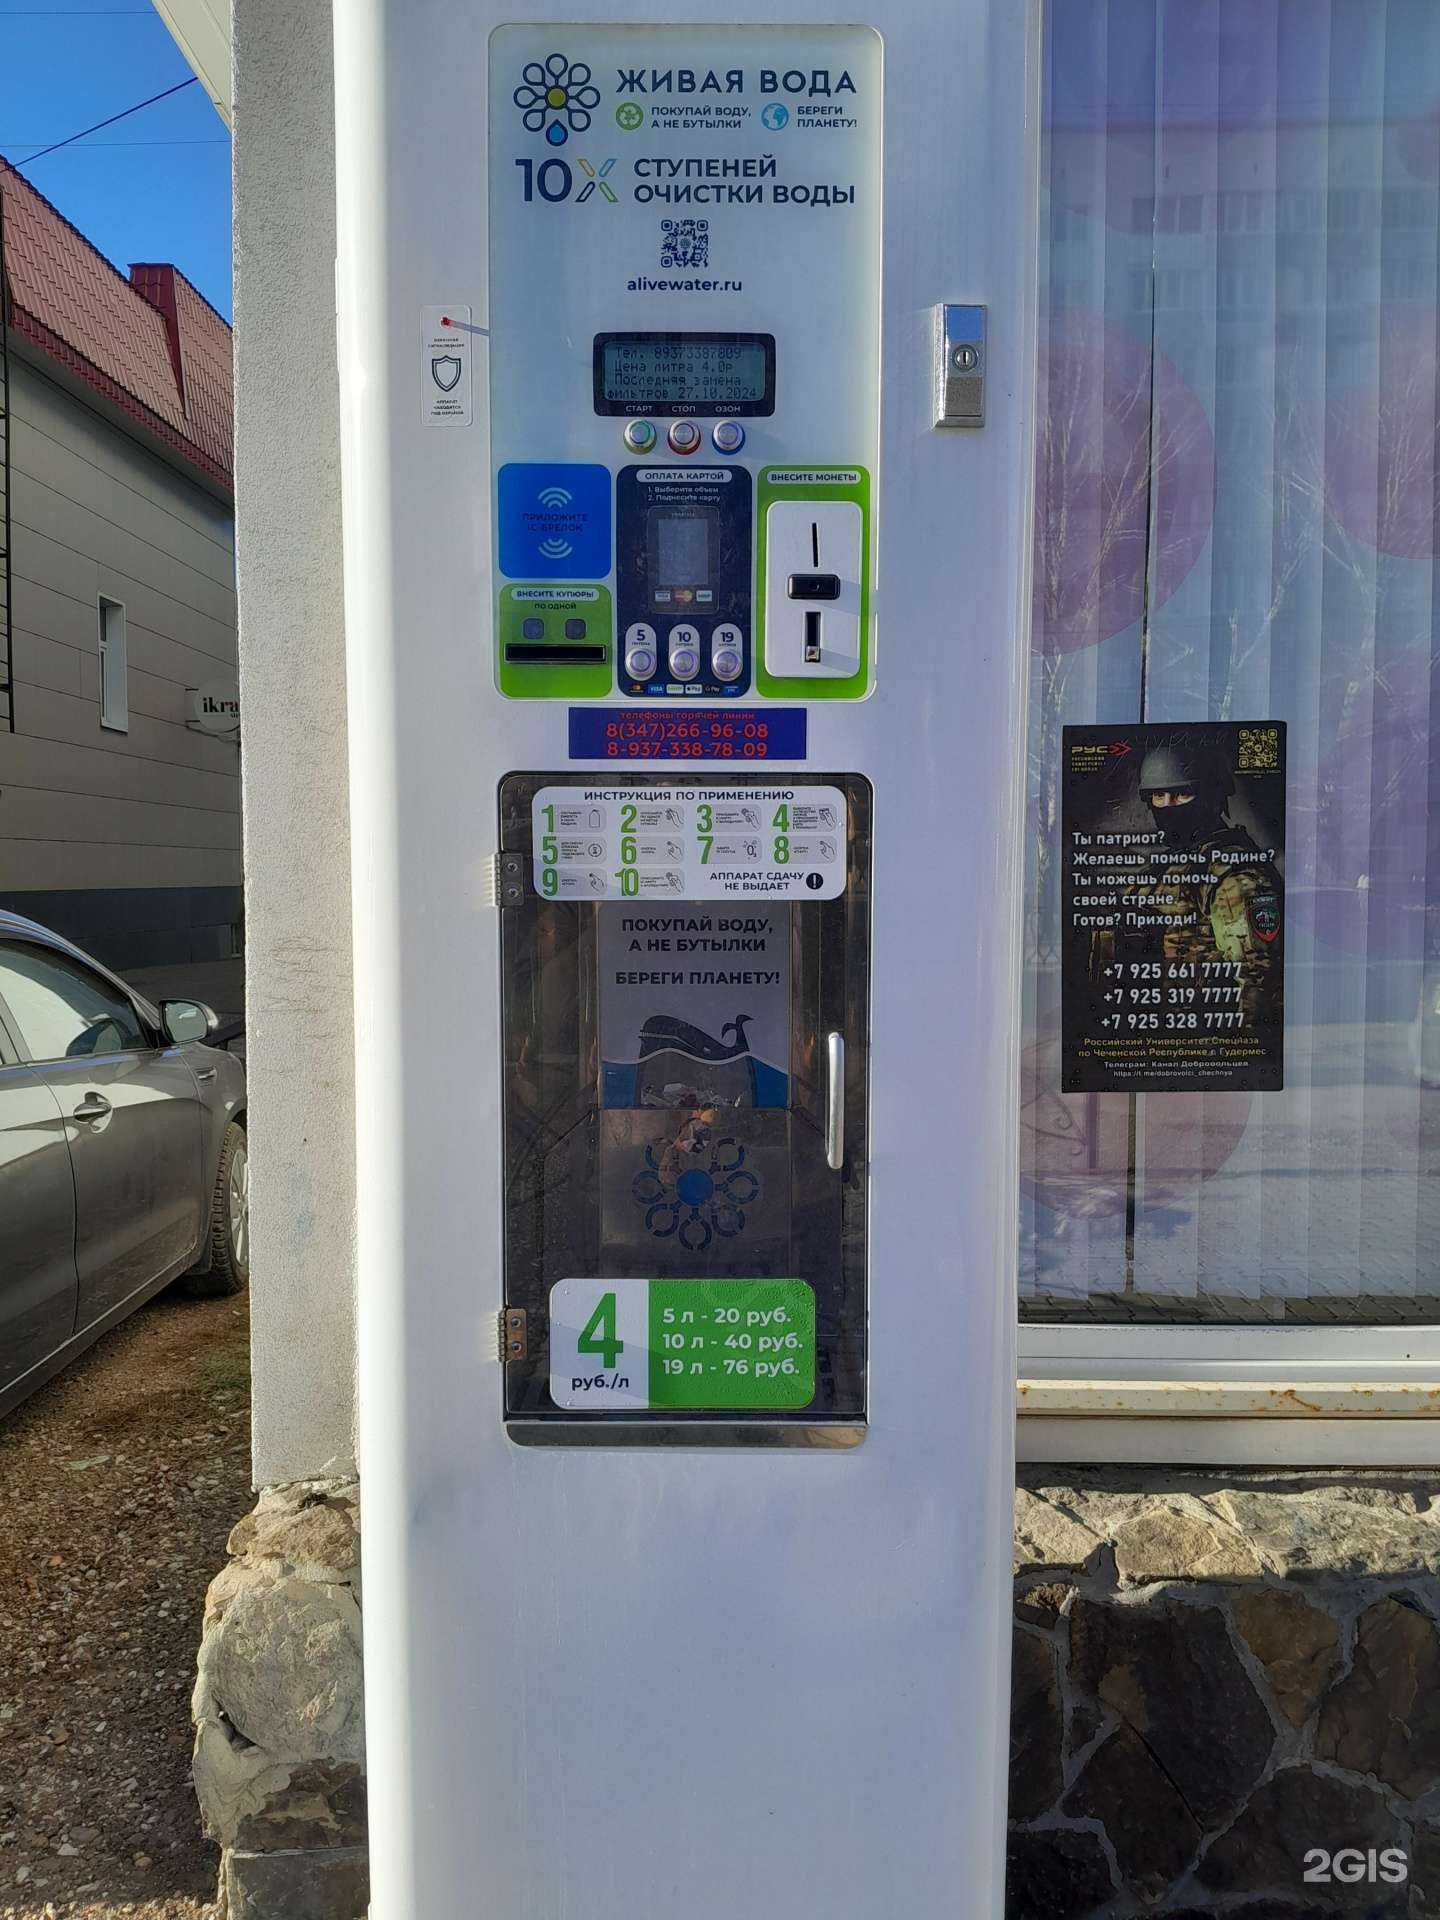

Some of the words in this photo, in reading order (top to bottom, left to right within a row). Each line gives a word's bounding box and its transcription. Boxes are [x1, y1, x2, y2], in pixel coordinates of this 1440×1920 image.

[615, 69, 744, 94] ЖИВАЯ
[759, 69, 857, 98] ВОДА
[651, 104, 712, 117] ПОКУПАЙ
[715, 105, 752, 119] ВОДУ,
[796, 105, 843, 116] БЕРЕГИ
[651, 119, 660, 129] А
[662, 119, 681, 129] НЕ
[683, 119, 742, 129] БУТЫЛКИ
[796, 119, 858, 129] ПЛАНЕТУ!
[633, 154, 777, 178] СТУПЕНЕЙ
[633, 184, 763, 204] ОЧИСТКИ
[772, 184, 855, 207] ВОДЫ
[626, 277, 743, 292] alivewater.ru
[614, 360, 647, 373] Цена
[654, 361, 694, 373] литра
[614, 373, 686, 386] Последняя
[625, 405, 653, 413] СТАРТ
[671, 405, 696, 413] СТОП
[715, 405, 741, 413] ОЗОН
[644, 472, 684, 481] ОПЛАТА
[686, 471, 725, 481] КАРТОЙ
[770, 472, 812, 482] ВНЕСИТЕ
[814, 472, 858, 482] МОНЕТЫ
[522, 513, 589, 522] ПРИЛОЖИТЕ
[516, 590, 555, 598] ВНЕСИТЕ
[556, 590, 594, 599] КУПЮРЫ
[547, 602, 577, 611] ОДНОЙ
[636, 629, 646, 642] 5
[676, 631, 692, 643] 10
[720, 631, 734, 643] 19
[202, 697, 239, 713] ikra
[620, 711, 673, 721] телефоны
[606, 723, 769, 741] 8(347)266-96-08
[607, 742, 768, 757] 8-937-338-78-09
[584, 791, 673, 802] ИНСТРУКЦИЯ
[676, 791, 696, 801] ПО
[699, 790, 795, 801] ПРИМЕНЕНИЮ
[541, 804, 554, 833] 1
[620, 804, 638, 833] 2
[696, 804, 713, 833] 3
[772, 803, 790, 833] 4
[1071, 832, 1092, 845] Ты
[1096, 830, 1165, 848] патриот?
[542, 835, 558, 865] 5
[621, 836, 637, 865] 6
[696, 835, 714, 864] 7
[773, 835, 790, 865] 8
[1072, 852, 1145, 866] Желаешь
[1150, 852, 1206, 865] помочь
[1211, 849, 1275, 864] Родине?
[542, 867, 558, 897] 9
[614, 867, 639, 897] 10
[709, 872, 764, 881] АППАРАТ
[766, 871, 805, 882] СДАЧУ
[1071, 872, 1092, 886] Ты
[1096, 874, 1158, 885] можешь
[1162, 874, 1219, 885] помочь
[724, 882, 740, 890] НЕ
[742, 882, 791, 891] ВЫДАЕТ
[1073, 892, 1117, 906] своей
[1121, 894, 1178, 907] стране.
[621, 914, 715, 933] ПОКУПАЙ
[718, 918, 773, 934] ВОДУ,
[1073, 912, 1121, 927] Готов?
[1126, 911, 1198, 927] Приходи!
[629, 938, 642, 952] А
[647, 939, 672, 952] НЕ
[675, 938, 766, 952] БУТЫЛКИ
[615, 972, 685, 985] БЕРЕГИ
[689, 971, 781, 985] ПЛАНЕТУ!
[1103, 963, 1124, 979] +7
[1130, 963, 1162, 979] 925
[1167, 962, 1195, 978] 661
[1201, 962, 1242, 978] 7777
[1103, 988, 1124, 1005] +7
[1129, 988, 1161, 1004] 925
[1167, 987, 1196, 1004] 319
[1201, 987, 1242, 1003] 7777
[1101, 1013, 1121, 1030] +7
[1127, 1013, 1159, 1029] 925
[1165, 1012, 1198, 1029] 328
[1203, 1012, 1244, 1028] 7777
[1083, 1037, 1143, 1047] Российский
[1146, 1037, 1211, 1047] Университет
[1093, 1048, 1146, 1057] Чеченской
[1149, 1048, 1208, 1059] Республике
[1219, 1047, 1267, 1058] Гудермес
[1103, 1061, 1149, 1070] Телеграм:
[662, 1308, 675, 1324] 5
[680, 1310, 694, 1324] л
[714, 1308, 740, 1324] 20
[746, 1307, 792, 1328] руб.
[576, 1292, 624, 1369] 4
[662, 1333, 685, 1349] 10
[690, 1335, 705, 1349] л
[724, 1333, 752, 1349] 40
[758, 1333, 803, 1353] руб.
[662, 1359, 684, 1375] 19
[689, 1361, 703, 1375] л
[723, 1359, 749, 1375] 76
[755, 1359, 800, 1379] руб.
[571, 1374, 630, 1391] руб./л
